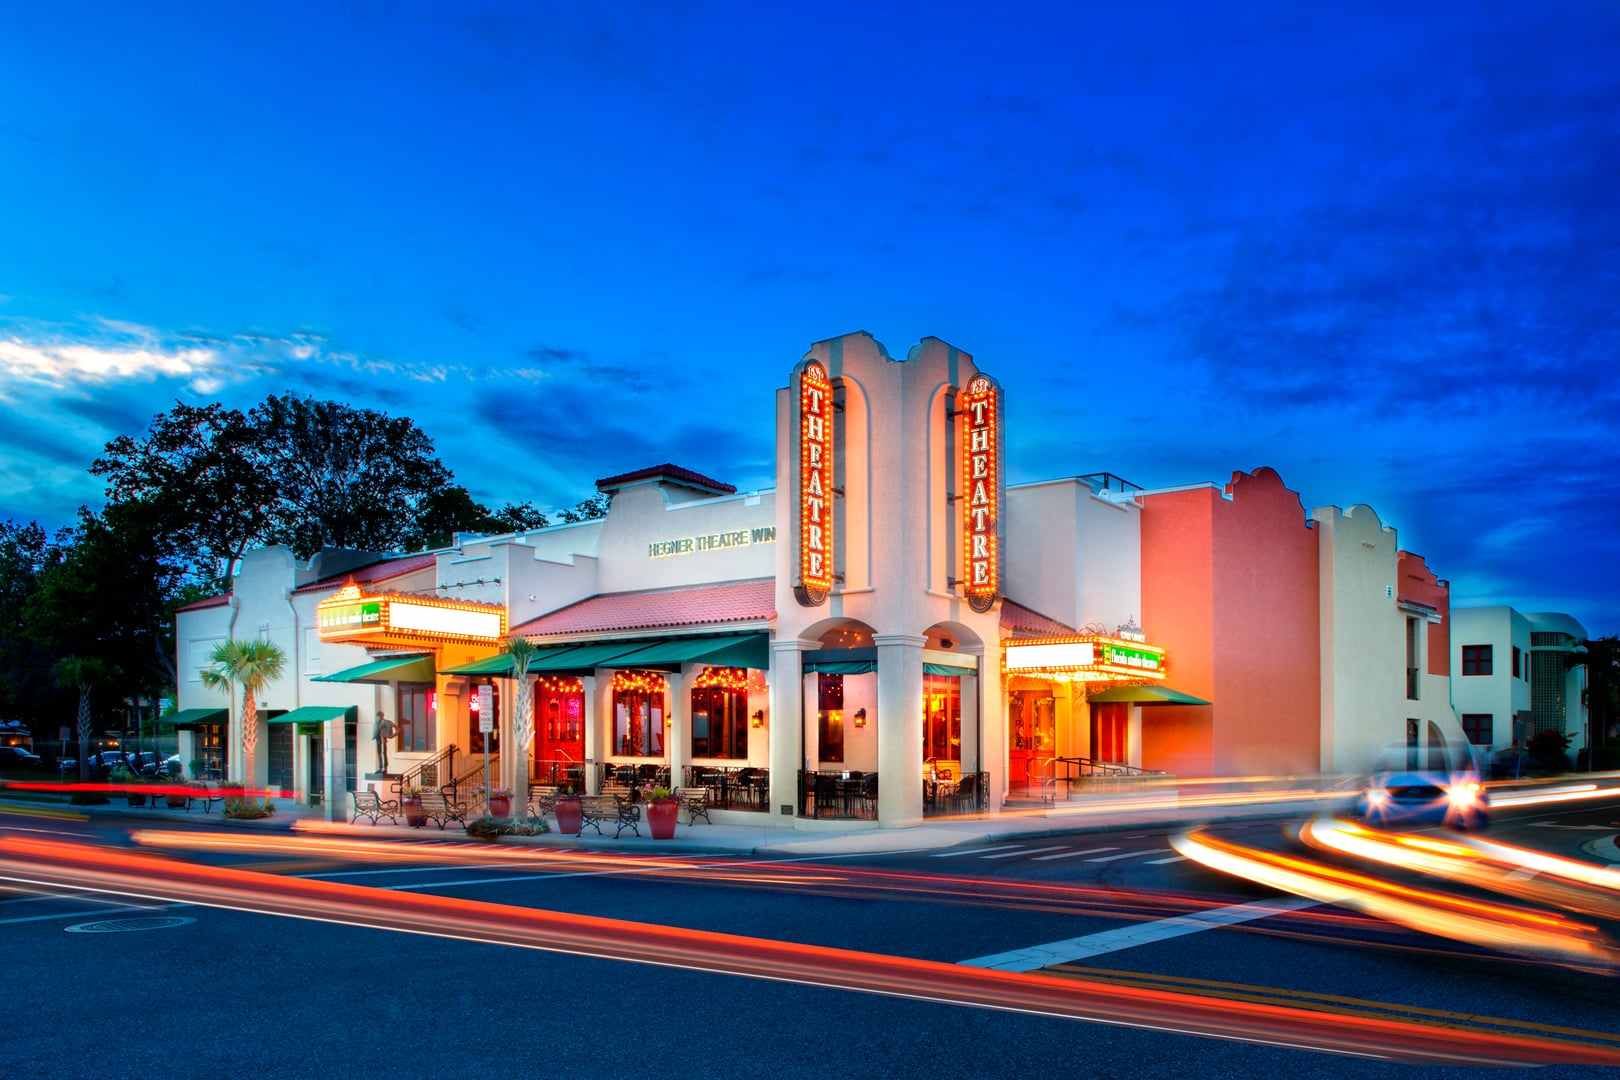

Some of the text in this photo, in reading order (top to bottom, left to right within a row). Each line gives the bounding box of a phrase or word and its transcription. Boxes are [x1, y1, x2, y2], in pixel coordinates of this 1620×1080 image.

[648, 538, 694, 557] HEGNER
[696, 530, 749, 551] THEATRE
[808, 386, 823, 577] THEATRE
[970, 399, 989, 586] THEATRE
